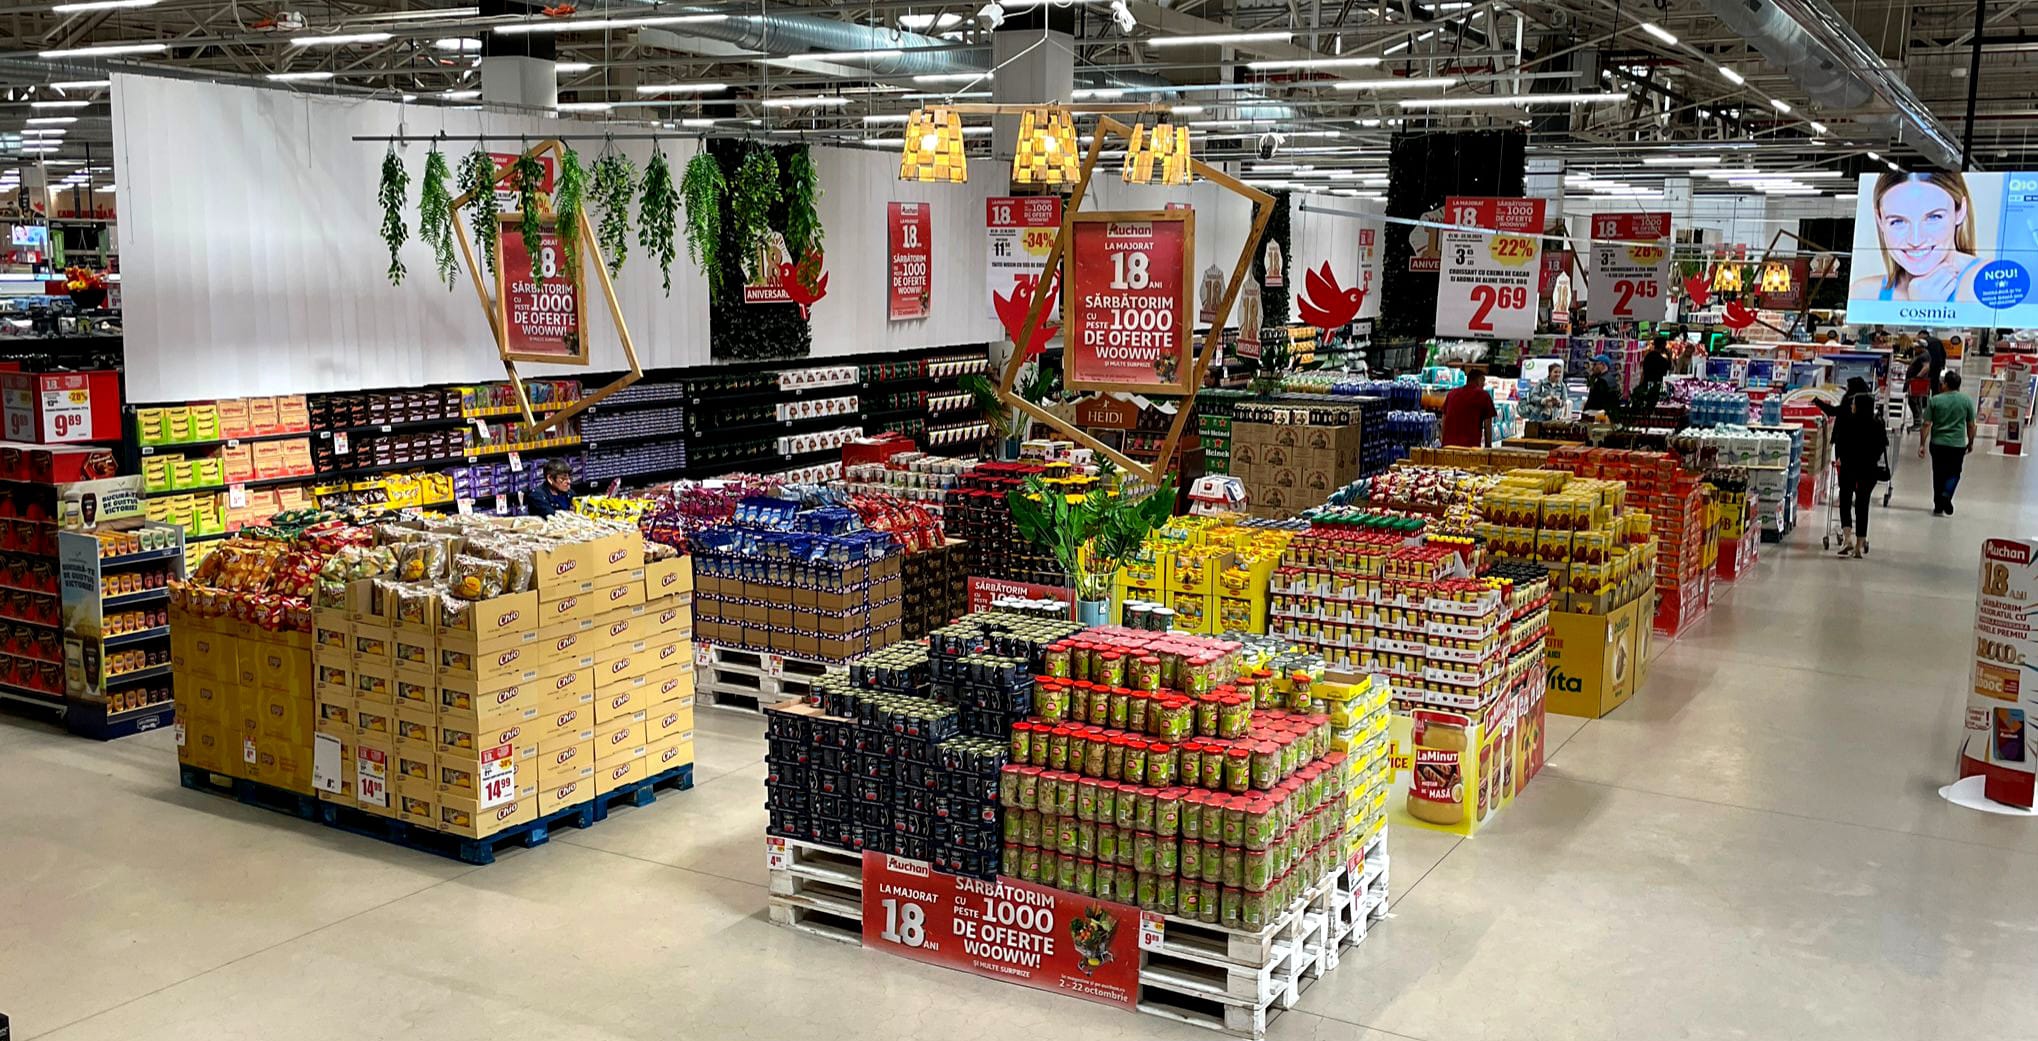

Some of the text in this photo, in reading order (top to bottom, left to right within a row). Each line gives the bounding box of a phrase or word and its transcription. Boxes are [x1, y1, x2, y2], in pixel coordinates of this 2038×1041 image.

[901, 206, 918, 214] Auchan
[992, 206, 1011, 225] 18
[1453, 207, 1477, 227] 18
[1507, 207, 1533, 215] 1000
[902, 225, 917, 248] 18
[1108, 223, 1152, 236] Auchan
[1598, 221, 1617, 238] 18
[1023, 231, 1055, 248] -34%
[1105, 242, 1154, 250] LA MAJORAT
[1492, 239, 1532, 257] -22%
[903, 263, 926, 276] 1000
[1110, 251, 1150, 290] 18
[1411, 259, 1440, 269] ANIVE
[893, 276, 926, 287] DE OFERTE
[1985, 268, 2018, 281] NOU!
[1149, 281, 1163, 289] ANI
[531, 294, 573, 312] 1000
[1085, 293, 1173, 310] SĂRBĂTORIM
[514, 312, 576, 326] DE OFERTE
[1086, 313, 1097, 321] CU
[1110, 309, 1173, 331] 1000
[1900, 305, 1956, 320] cosmia
[522, 325, 567, 336] WOOWW!
[1084, 331, 1173, 347] DE OFERTE
[1096, 346, 1161, 360] WOOWW!
[1088, 410, 1123, 424] HEIDI
[609, 549, 627, 564] Chio
[1987, 541, 2026, 560] Auchan
[557, 559, 577, 575] Chio
[661, 572, 678, 587] Chio
[1982, 561, 2009, 597] 18
[610, 585, 629, 601] Chio
[975, 581, 1028, 596] SĂRBĂTORIM
[2009, 590, 2027, 600] ANI
[558, 597, 577, 613] Chio
[974, 604, 987, 613] DE
[498, 610, 520, 627] Chio
[660, 608, 677, 624] Chio
[2015, 612, 2027, 621] CU
[610, 621, 629, 636] Chio
[1997, 628, 2028, 640] PREMIU
[556, 634, 577, 651] Chio
[498, 649, 520, 665] Chio
[660, 644, 677, 660] Chio
[611, 657, 630, 674] Chio
[556, 673, 577, 689] Chio
[661, 678, 679, 694] Chio
[496, 686, 519, 704] Chio
[612, 693, 630, 709] Chio
[557, 710, 577, 727] Chio
[661, 713, 679, 728] Chio
[499, 726, 520, 744] Chio
[612, 728, 630, 745] Chio
[556, 747, 577, 764] Chio
[661, 746, 679, 762] Chio
[612, 763, 631, 780] Chio
[557, 782, 577, 799] Chio
[1429, 787, 1451, 799] MASĂ
[496, 802, 518, 820] Chio
[888, 858, 928, 875] Auchan
[880, 883, 939, 904] LA MAJORAT
[954, 896, 967, 906] CU
[953, 906, 980, 919] PESTE
[982, 897, 1054, 934] 1000
[880, 899, 925, 947] 18
[953, 918, 1054, 956] DE OFERTE
[923, 940, 939, 951] ANI
[963, 939, 1041, 969] WOOWW!
[979, 960, 1000, 973] MULTE
[1000, 965, 1031, 978] SURPRIZE
[1059, 979, 1129, 1003] 2 22 octombrie
